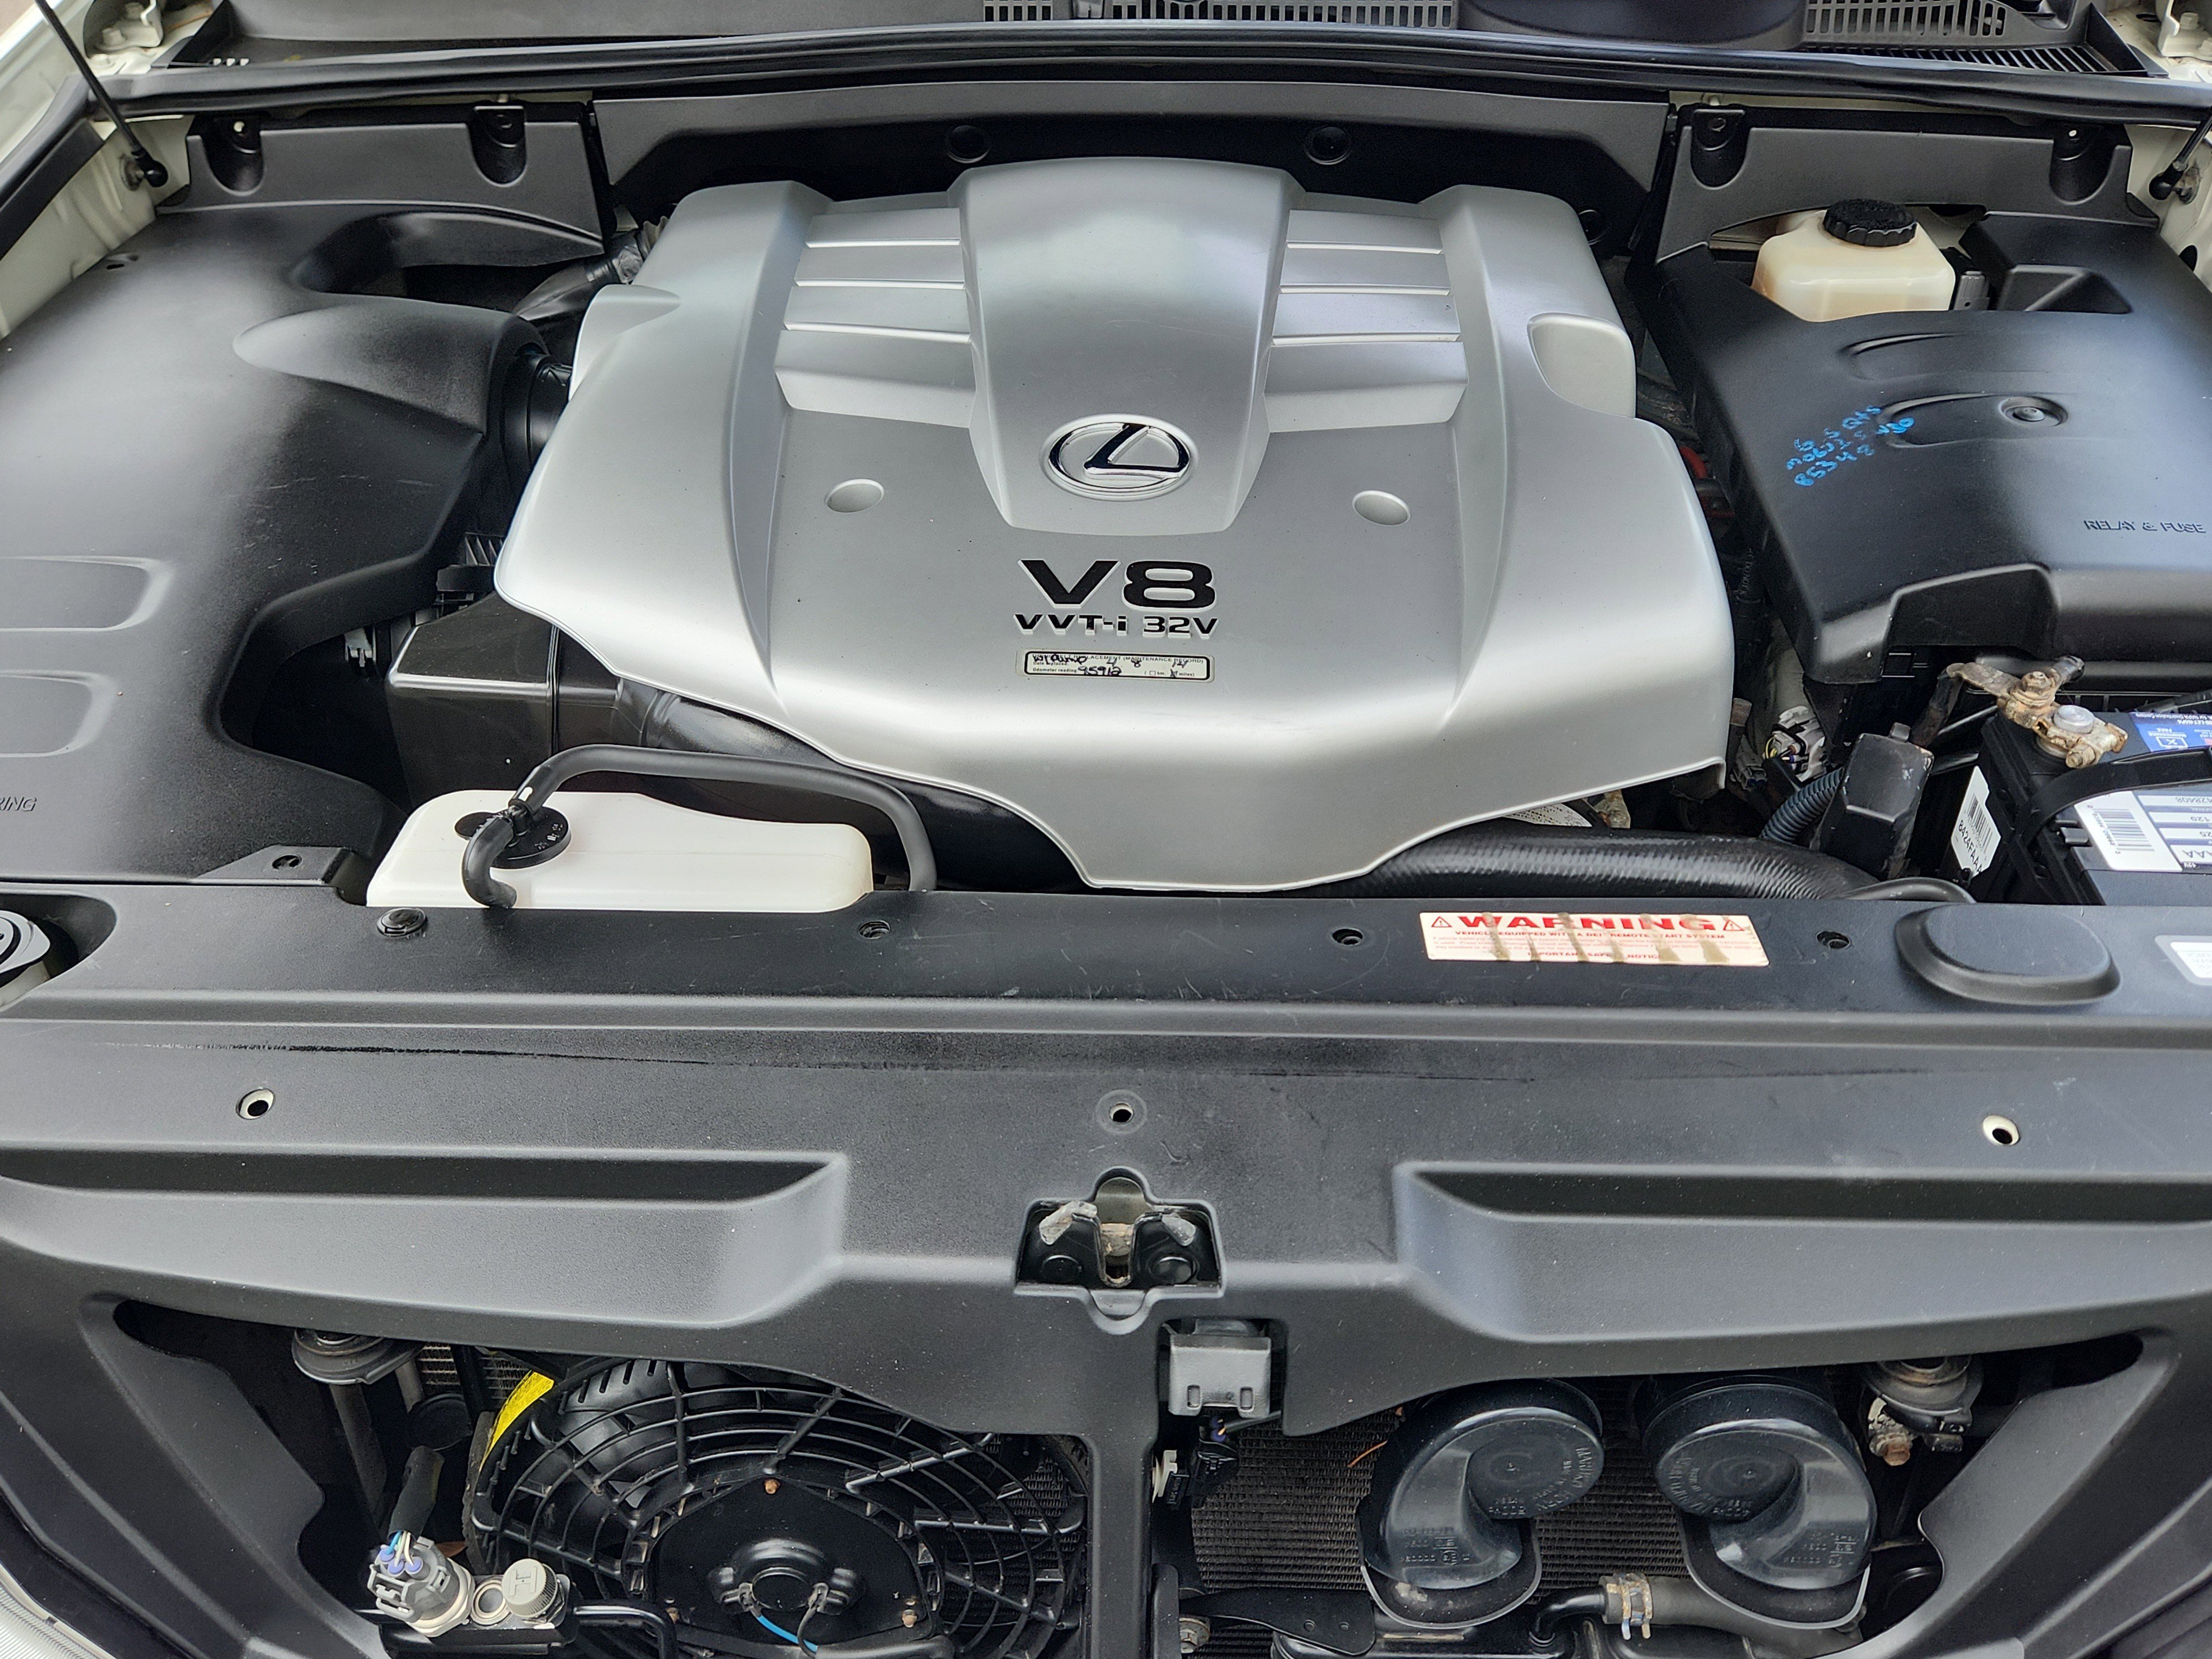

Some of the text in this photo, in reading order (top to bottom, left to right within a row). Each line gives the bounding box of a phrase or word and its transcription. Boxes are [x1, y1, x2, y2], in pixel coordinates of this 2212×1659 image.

[2084, 520, 2136, 531] RELAY
[2160, 522, 2206, 533] FUSE
[1018, 560, 1217, 611] V8
[1014, 614, 1219, 639] VVT-i 32V
[509, 1565, 538, 1597] H
